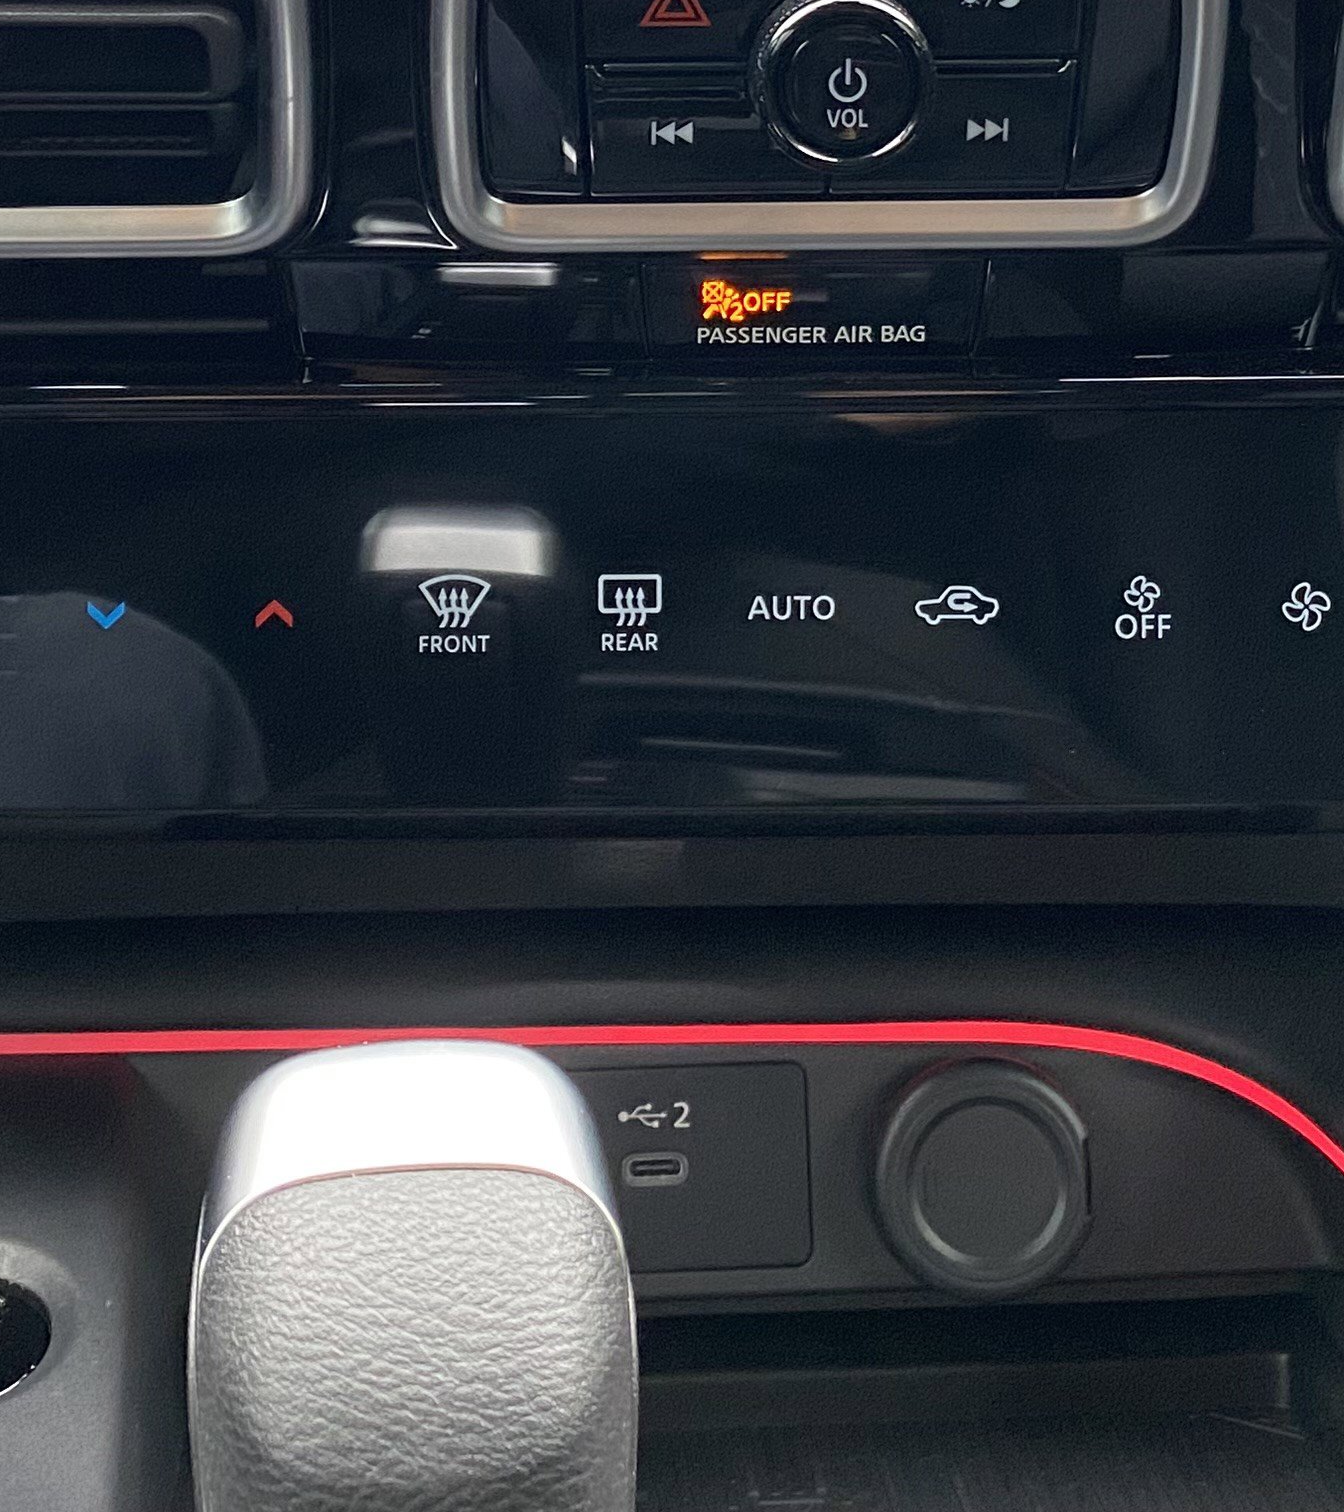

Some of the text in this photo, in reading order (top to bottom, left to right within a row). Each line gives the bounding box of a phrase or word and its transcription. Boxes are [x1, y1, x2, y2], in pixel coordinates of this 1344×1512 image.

[826, 108, 869, 128] VOL
[697, 325, 926, 344] PASSENGER AIR BAG
[747, 595, 836, 621] AUTO
[1113, 614, 1172, 640] OFF
[419, 634, 491, 653] FRONT
[601, 632, 658, 652] REAR
[673, 1101, 691, 1128] 2
